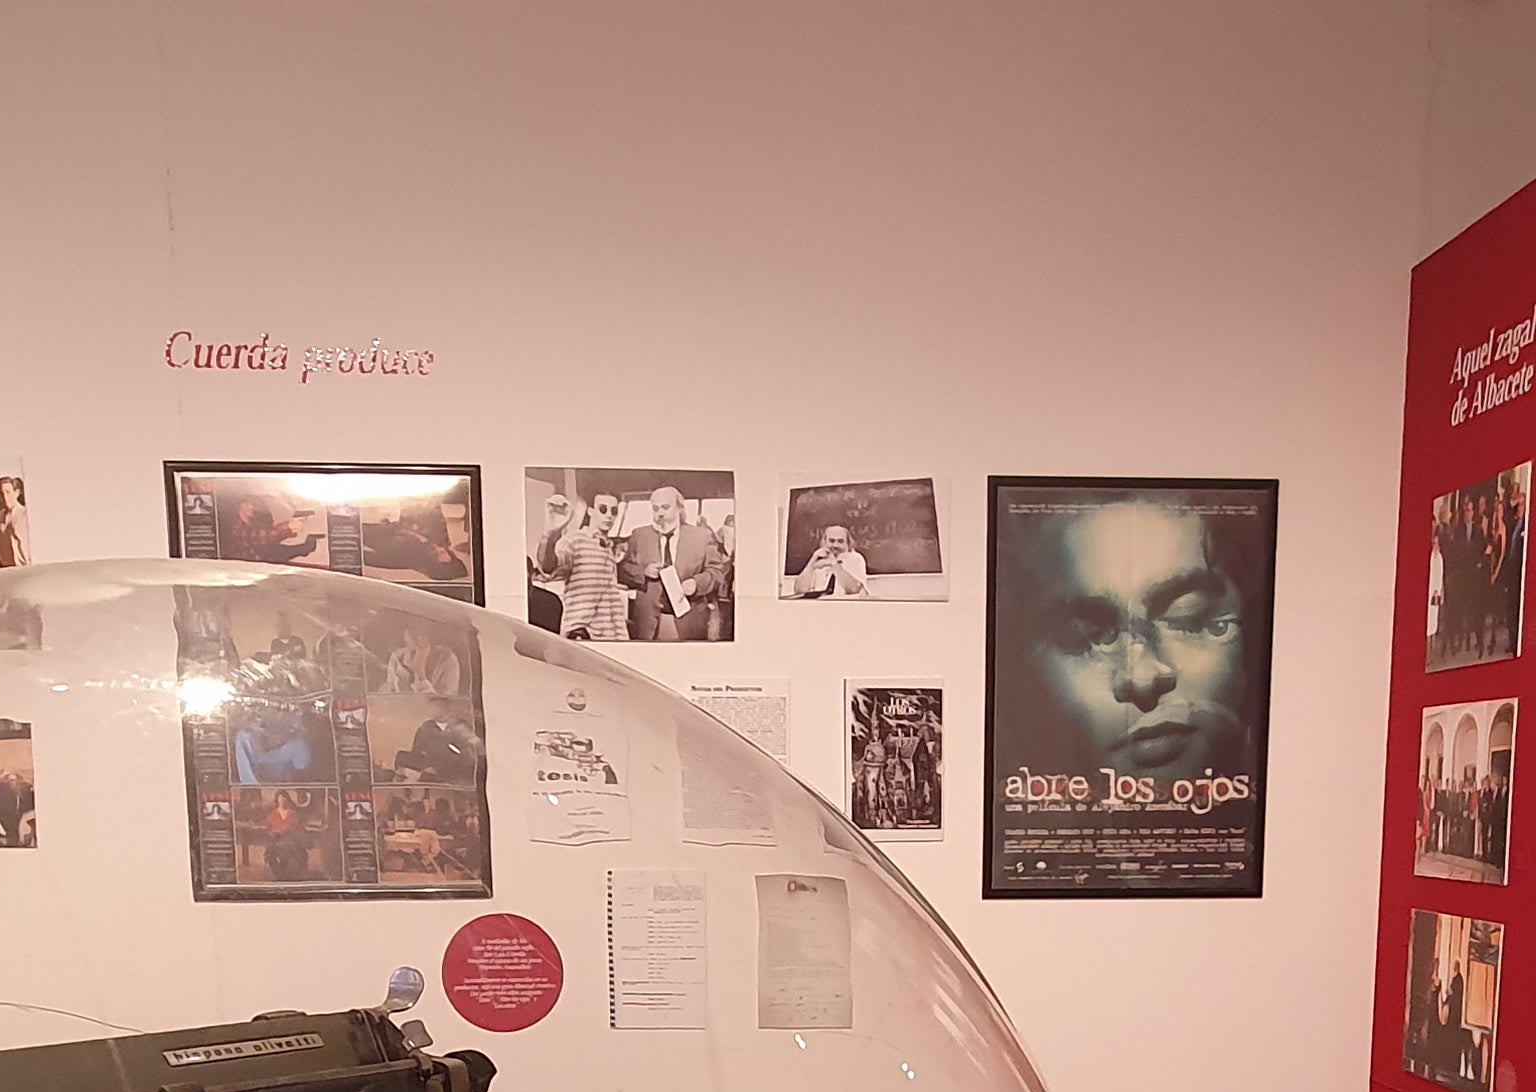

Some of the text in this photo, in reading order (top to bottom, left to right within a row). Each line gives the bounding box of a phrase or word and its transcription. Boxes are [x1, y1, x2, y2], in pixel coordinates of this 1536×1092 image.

[165, 331, 434, 384] Cuerda produce
[1449, 327, 1495, 388] Aquel
[1451, 362, 1534, 427] de Albacete
[1004, 766, 1250, 815] abre los ojos
